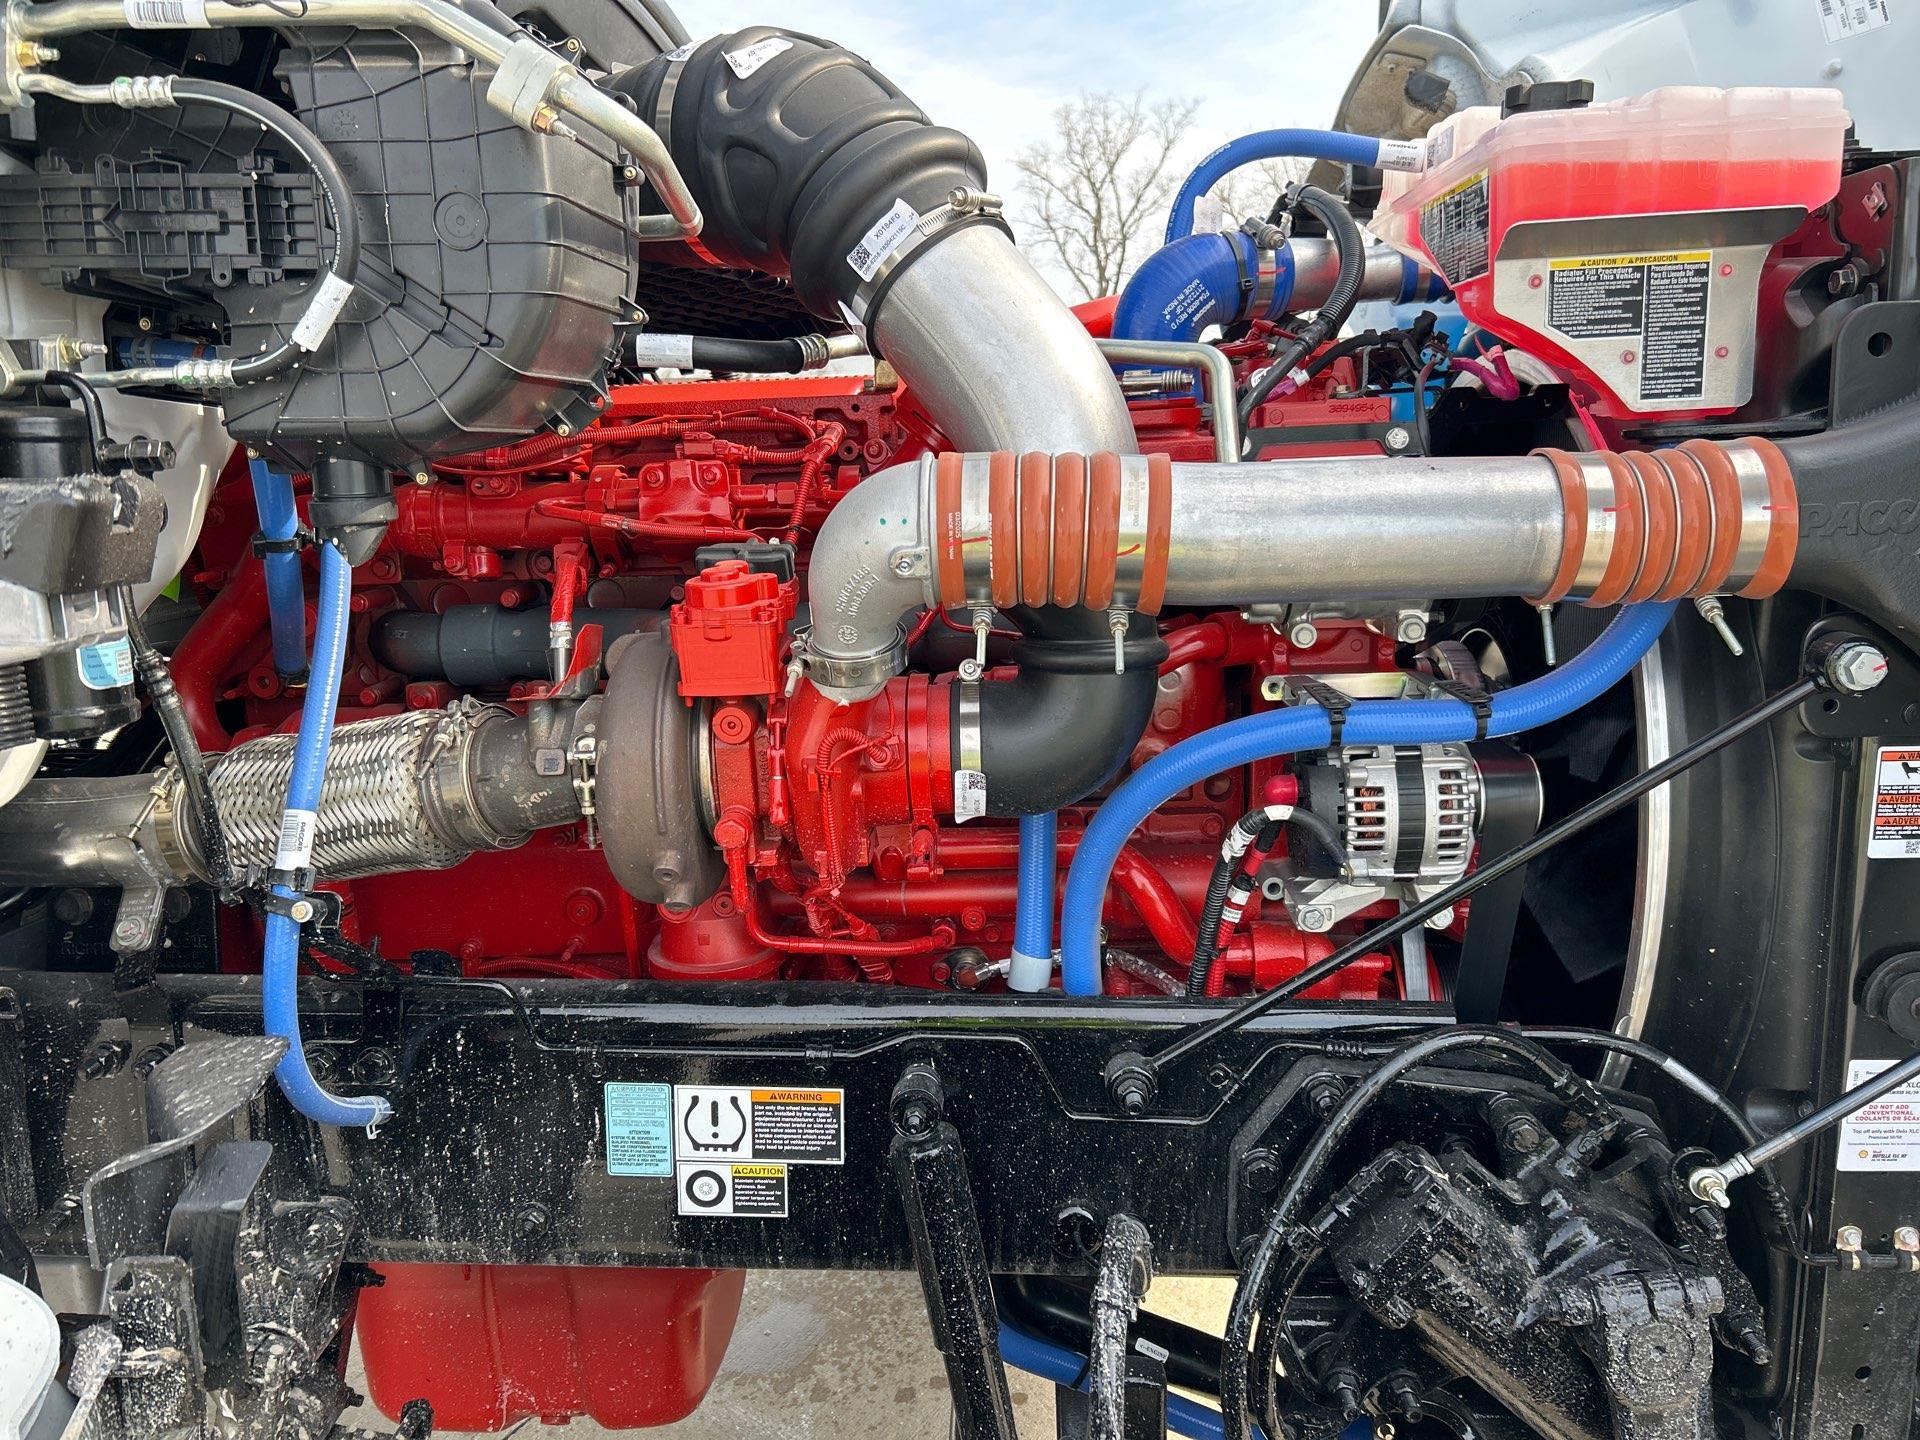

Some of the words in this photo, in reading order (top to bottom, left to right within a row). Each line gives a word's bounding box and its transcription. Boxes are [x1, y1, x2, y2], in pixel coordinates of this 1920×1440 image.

[1635, 255, 1678, 264] PRECAUCION
[1183, 279, 1200, 293] MADE
[1554, 275, 1584, 283] Required
[1162, 300, 1179, 315] INDIA
[1176, 312, 1188, 325] REV
[1800, 500, 1920, 537] PACC
[297, 822, 306, 851] PACCAR
